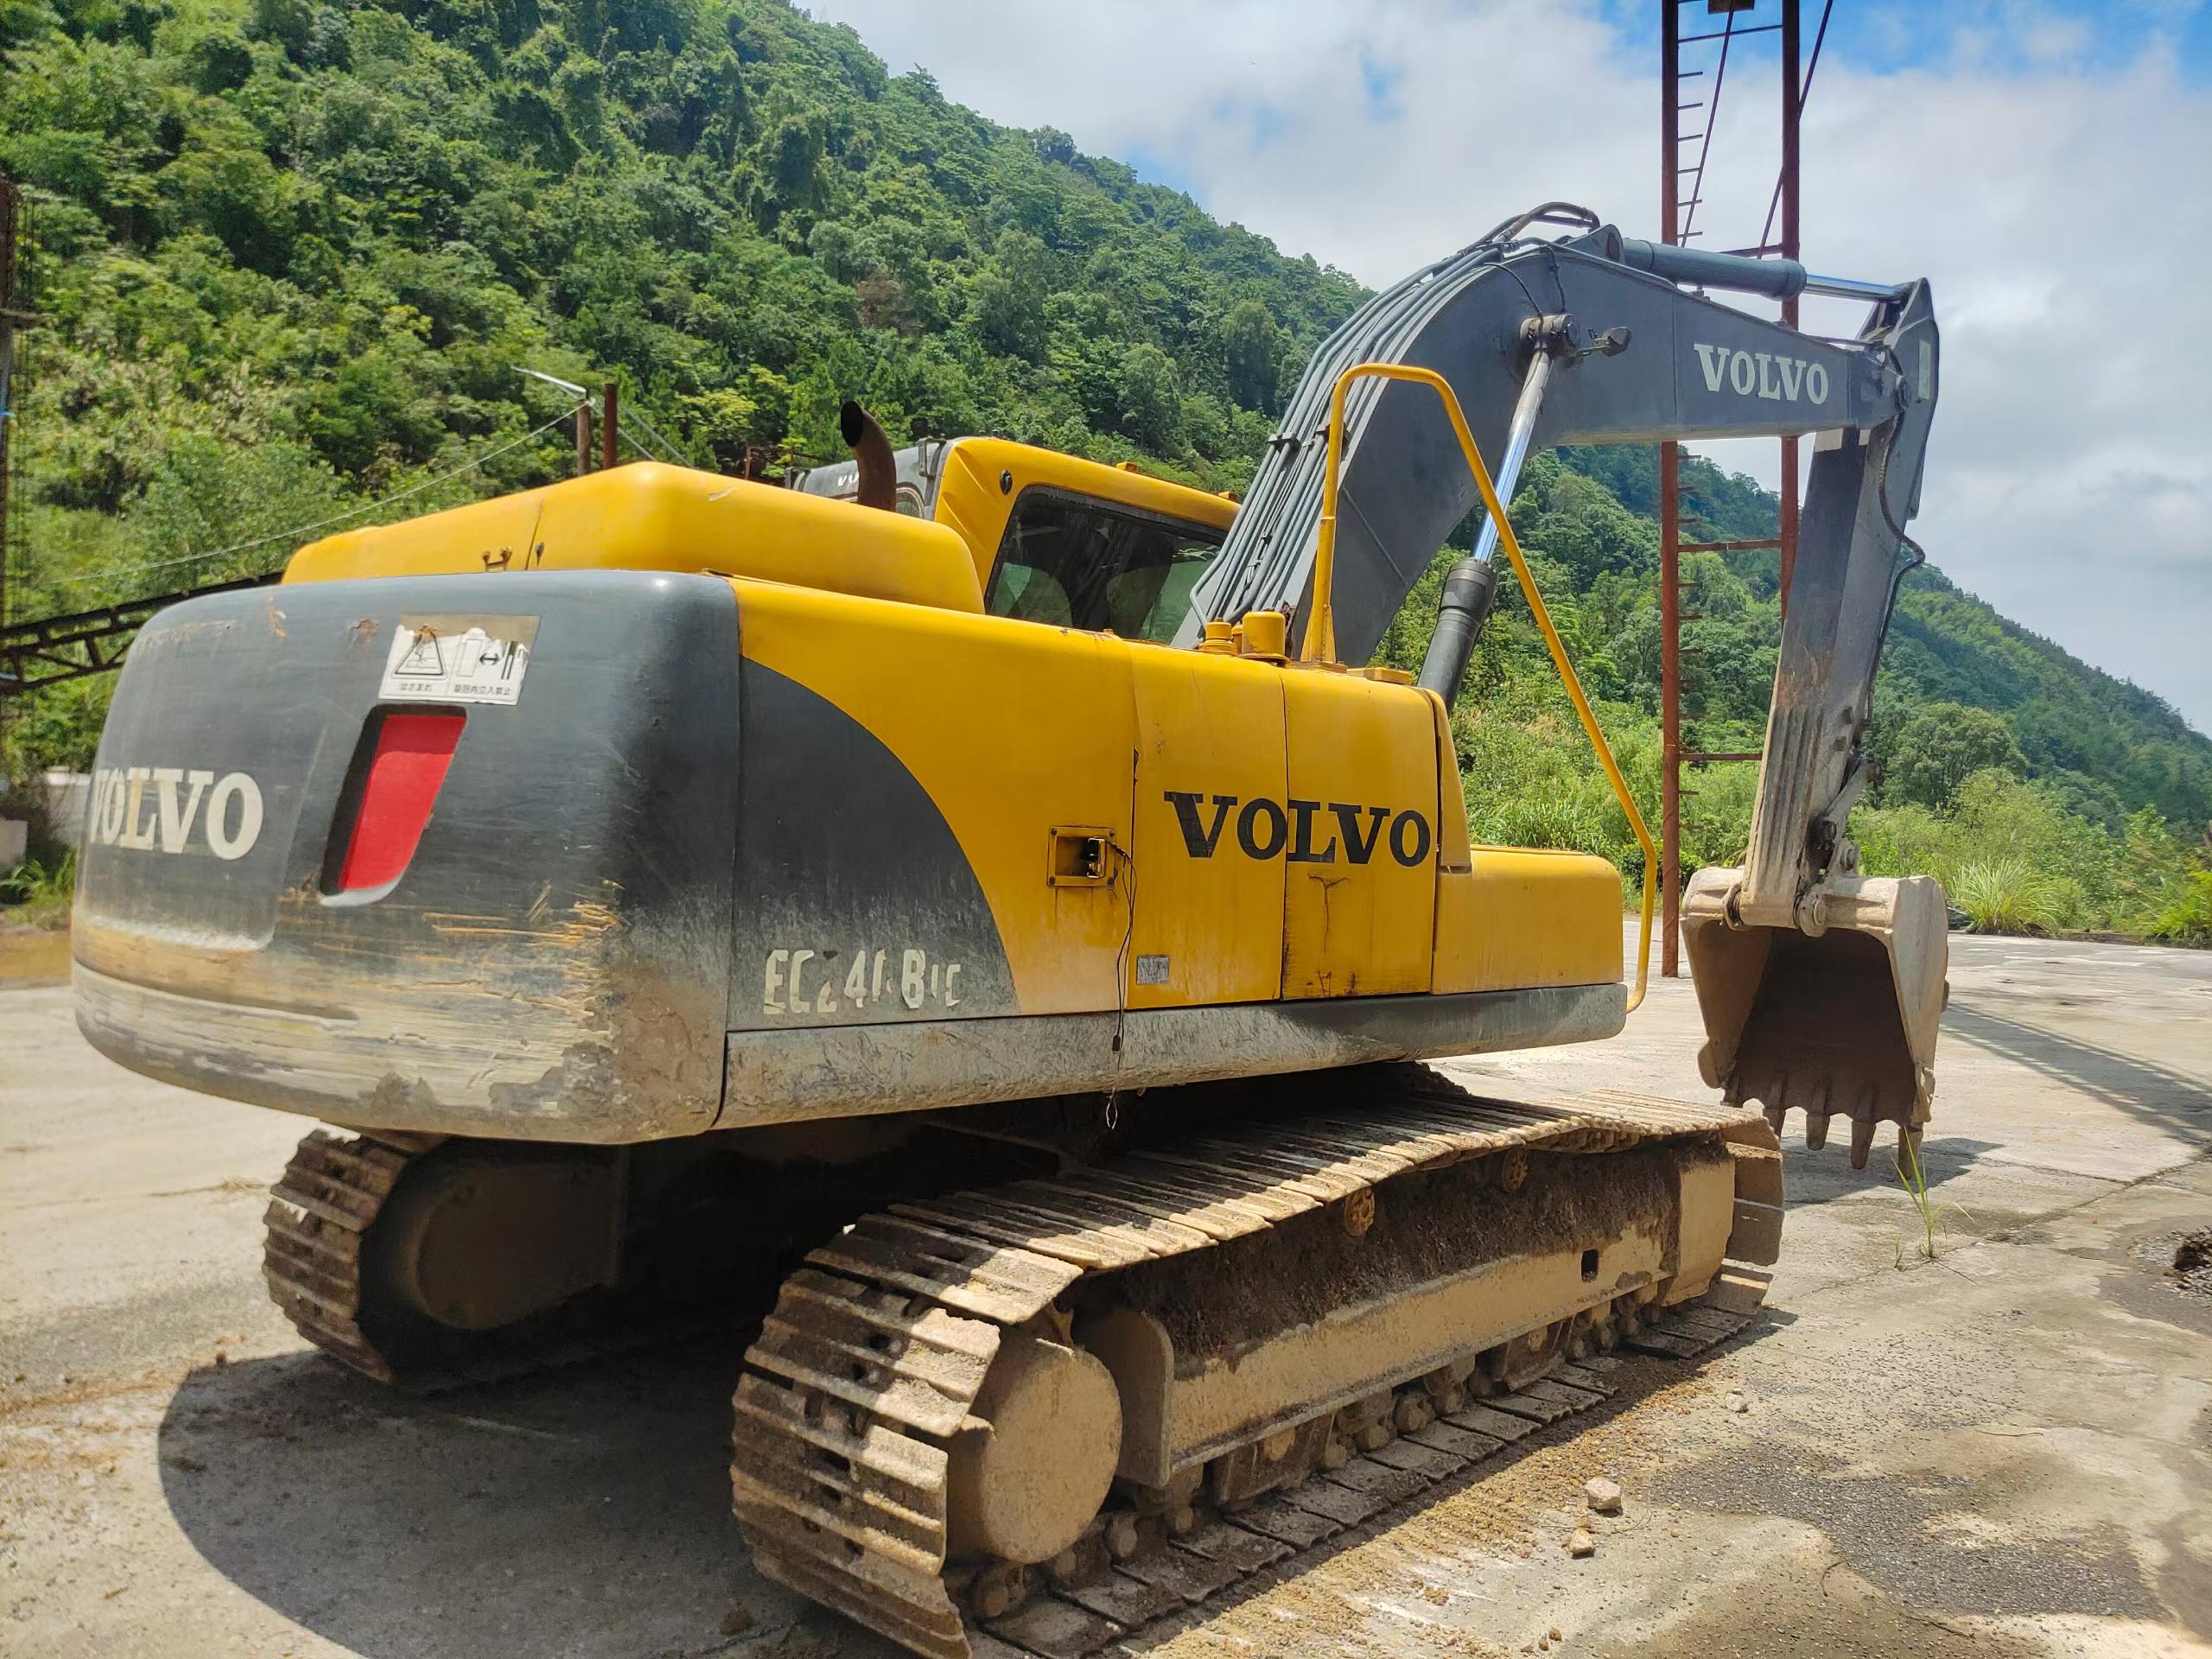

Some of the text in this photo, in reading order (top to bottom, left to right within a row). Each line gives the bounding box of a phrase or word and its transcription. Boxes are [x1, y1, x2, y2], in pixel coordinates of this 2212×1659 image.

[1694, 343, 1828, 405] VOLVO
[90, 767, 264, 861] VOLVO
[1164, 791, 1431, 867] VOLVO
